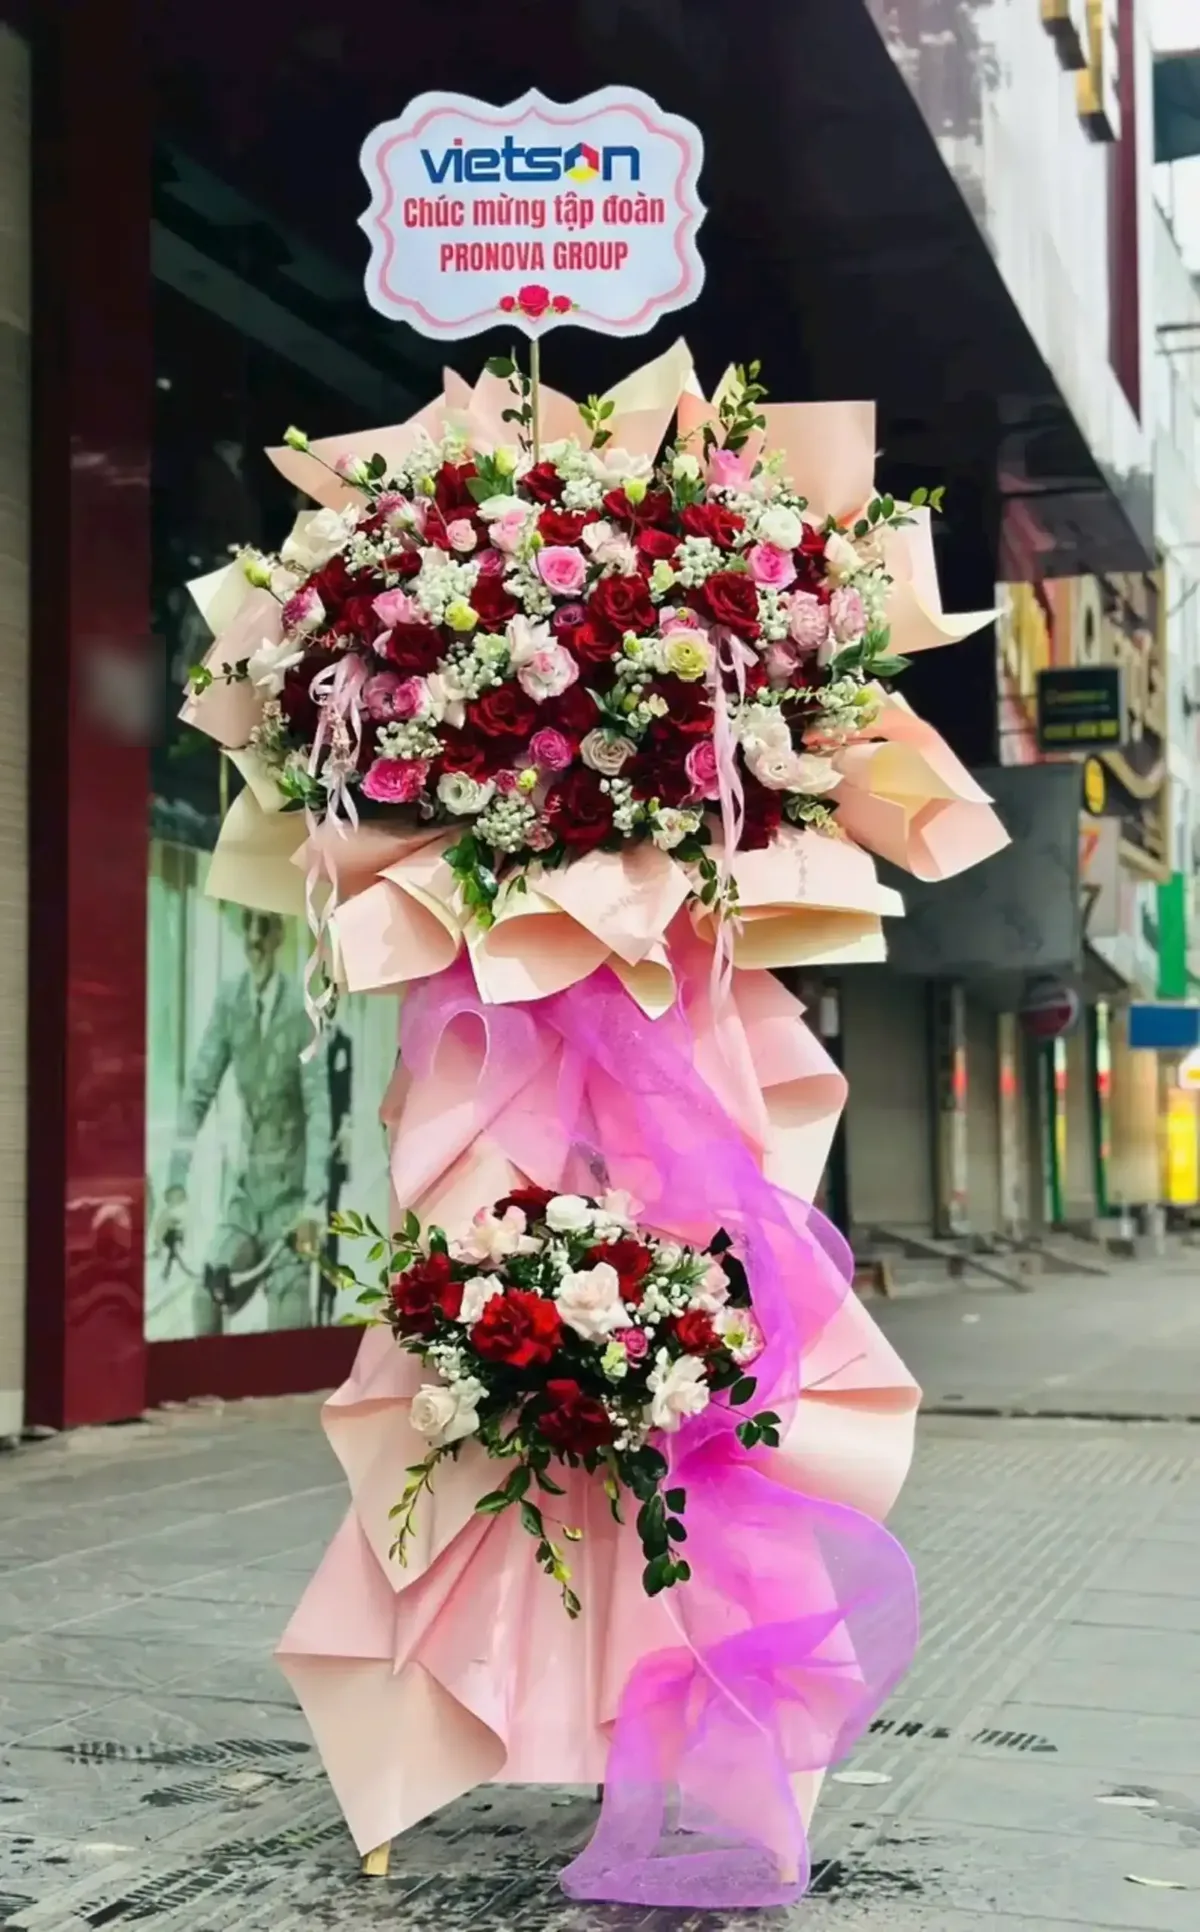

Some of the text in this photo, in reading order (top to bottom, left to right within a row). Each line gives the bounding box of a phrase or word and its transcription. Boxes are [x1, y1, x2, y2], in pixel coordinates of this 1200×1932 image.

[420, 136, 640, 184] vietson
[403, 191, 665, 231] Chúc mừng tập đoàn
[440, 241, 629, 272] PRONOVA GROUP
